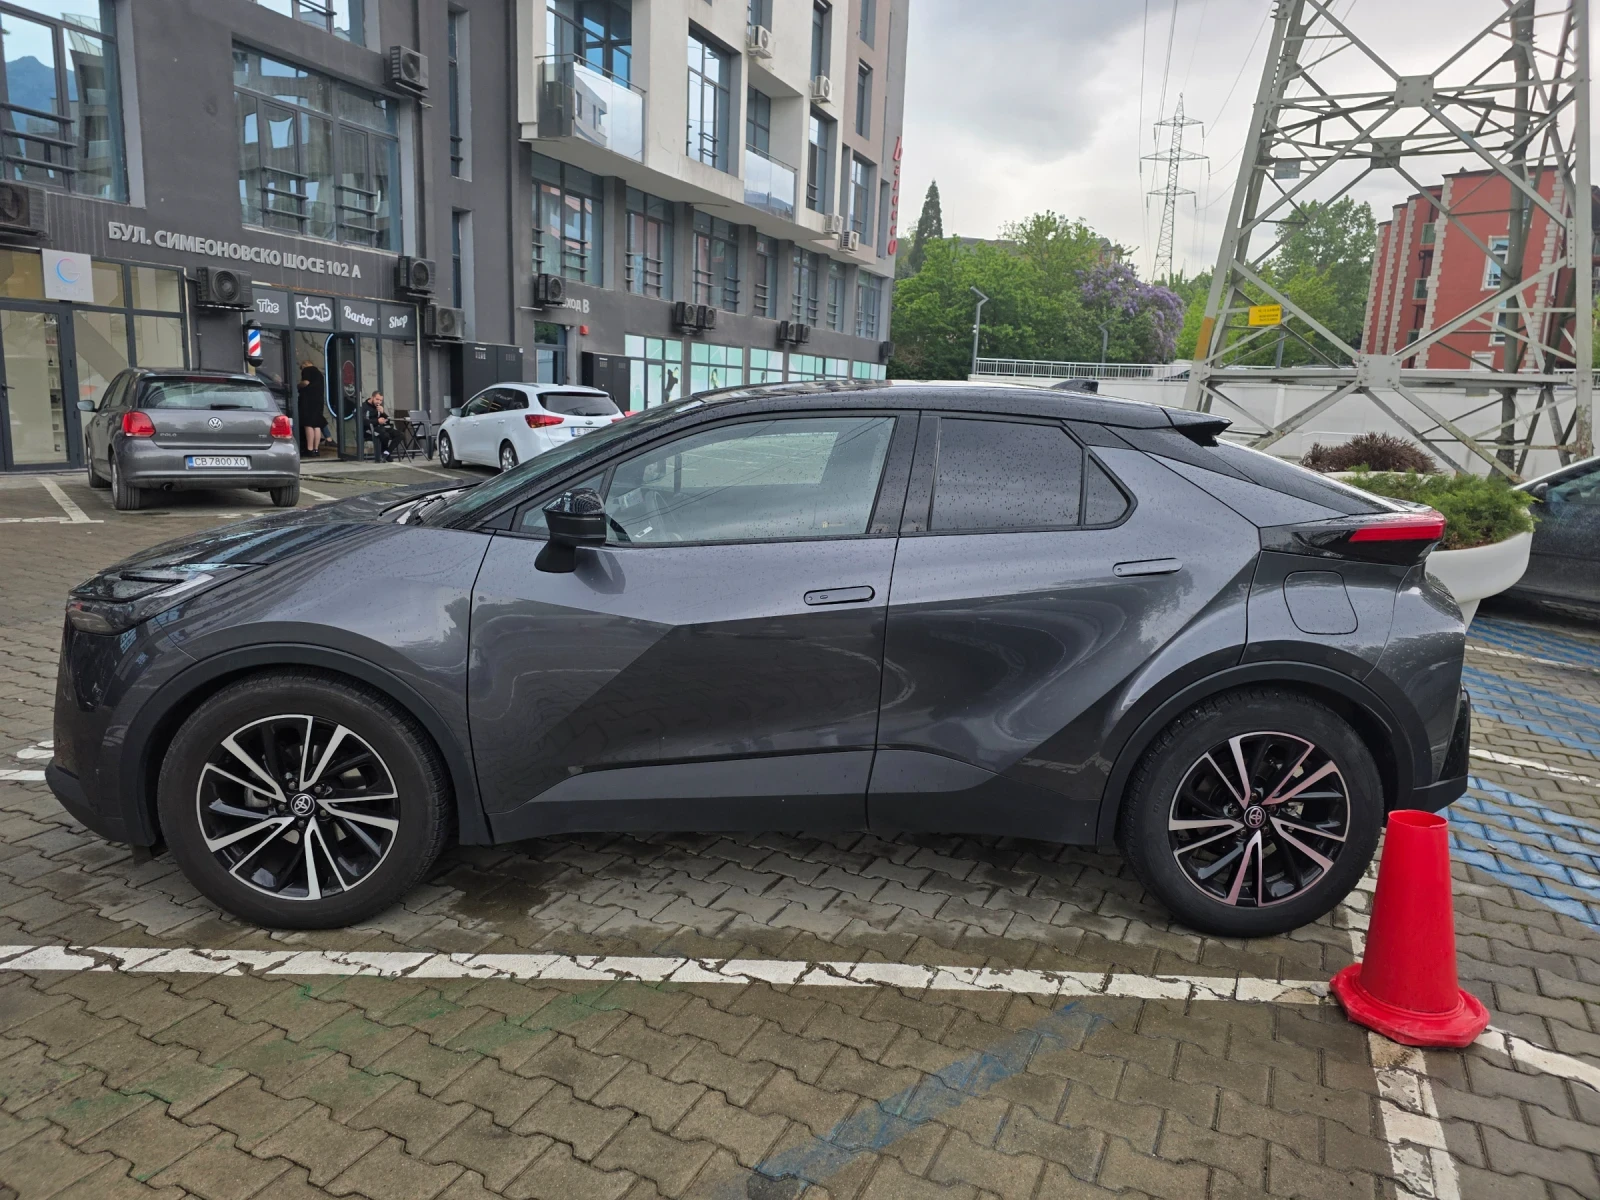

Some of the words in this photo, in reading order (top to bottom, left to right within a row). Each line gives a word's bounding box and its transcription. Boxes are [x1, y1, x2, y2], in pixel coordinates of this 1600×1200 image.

[108, 221, 152, 245] БУЛ.
[154, 230, 282, 266] СИМЕОНОВСКО
[283, 250, 325, 275] ШОСЕ
[326, 260, 349, 277] 102
[256, 298, 280, 314] The
[343, 305, 375, 327] Barber
[388, 315, 408, 329] Shop
[562, 298, 582, 312] ХОД
